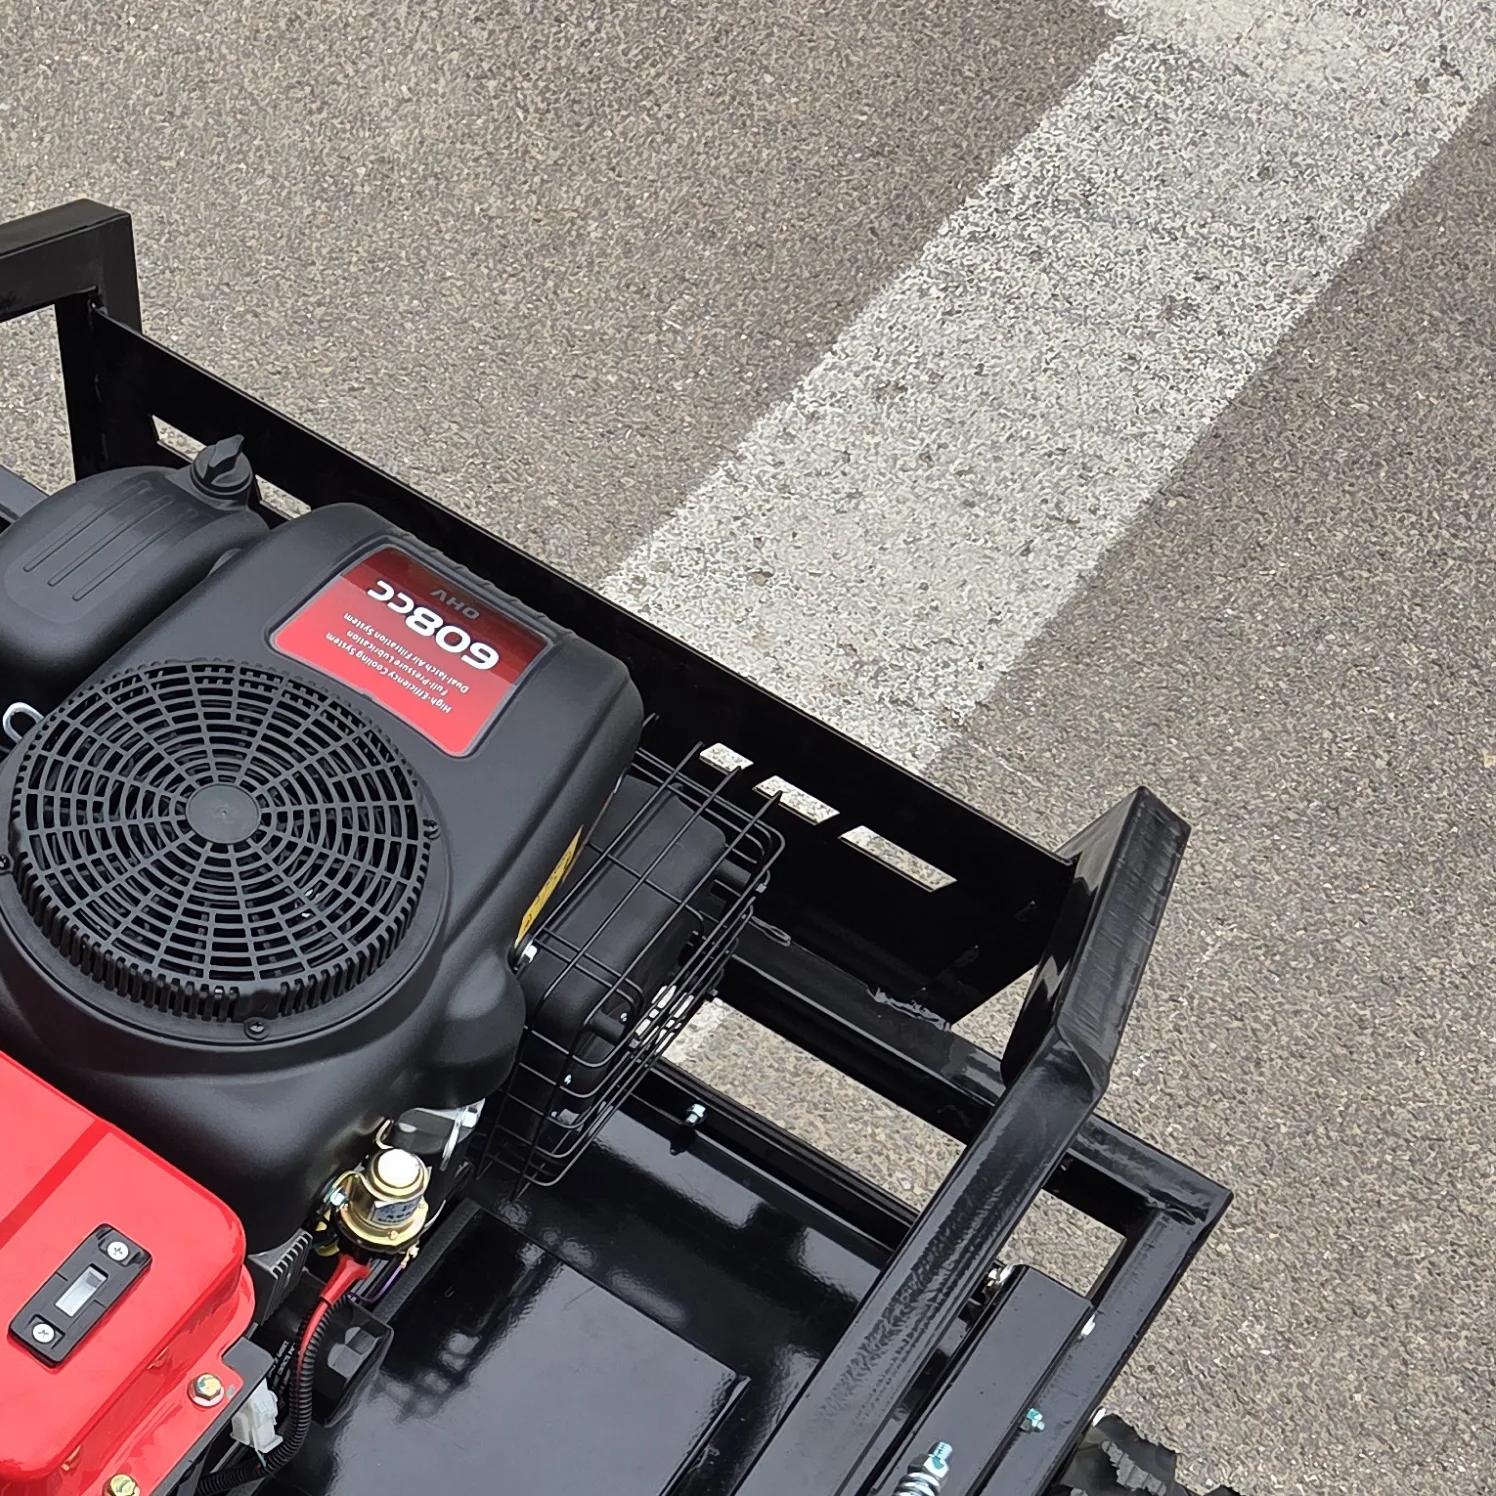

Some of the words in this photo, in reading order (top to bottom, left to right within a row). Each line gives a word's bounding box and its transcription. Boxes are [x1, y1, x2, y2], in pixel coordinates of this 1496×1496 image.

[429, 586, 480, 620] OHV
[342, 611, 375, 636] System
[367, 579, 501, 672] 608cc
[324, 631, 357, 655] System
[345, 628, 395, 664] Lubrication
[372, 630, 413, 660] Filtration
[354, 648, 389, 676] Cooling
[392, 657, 448, 696] Full-Pressure
[410, 654, 426, 667] Air
[387, 669, 452, 714] High-Efficiency
